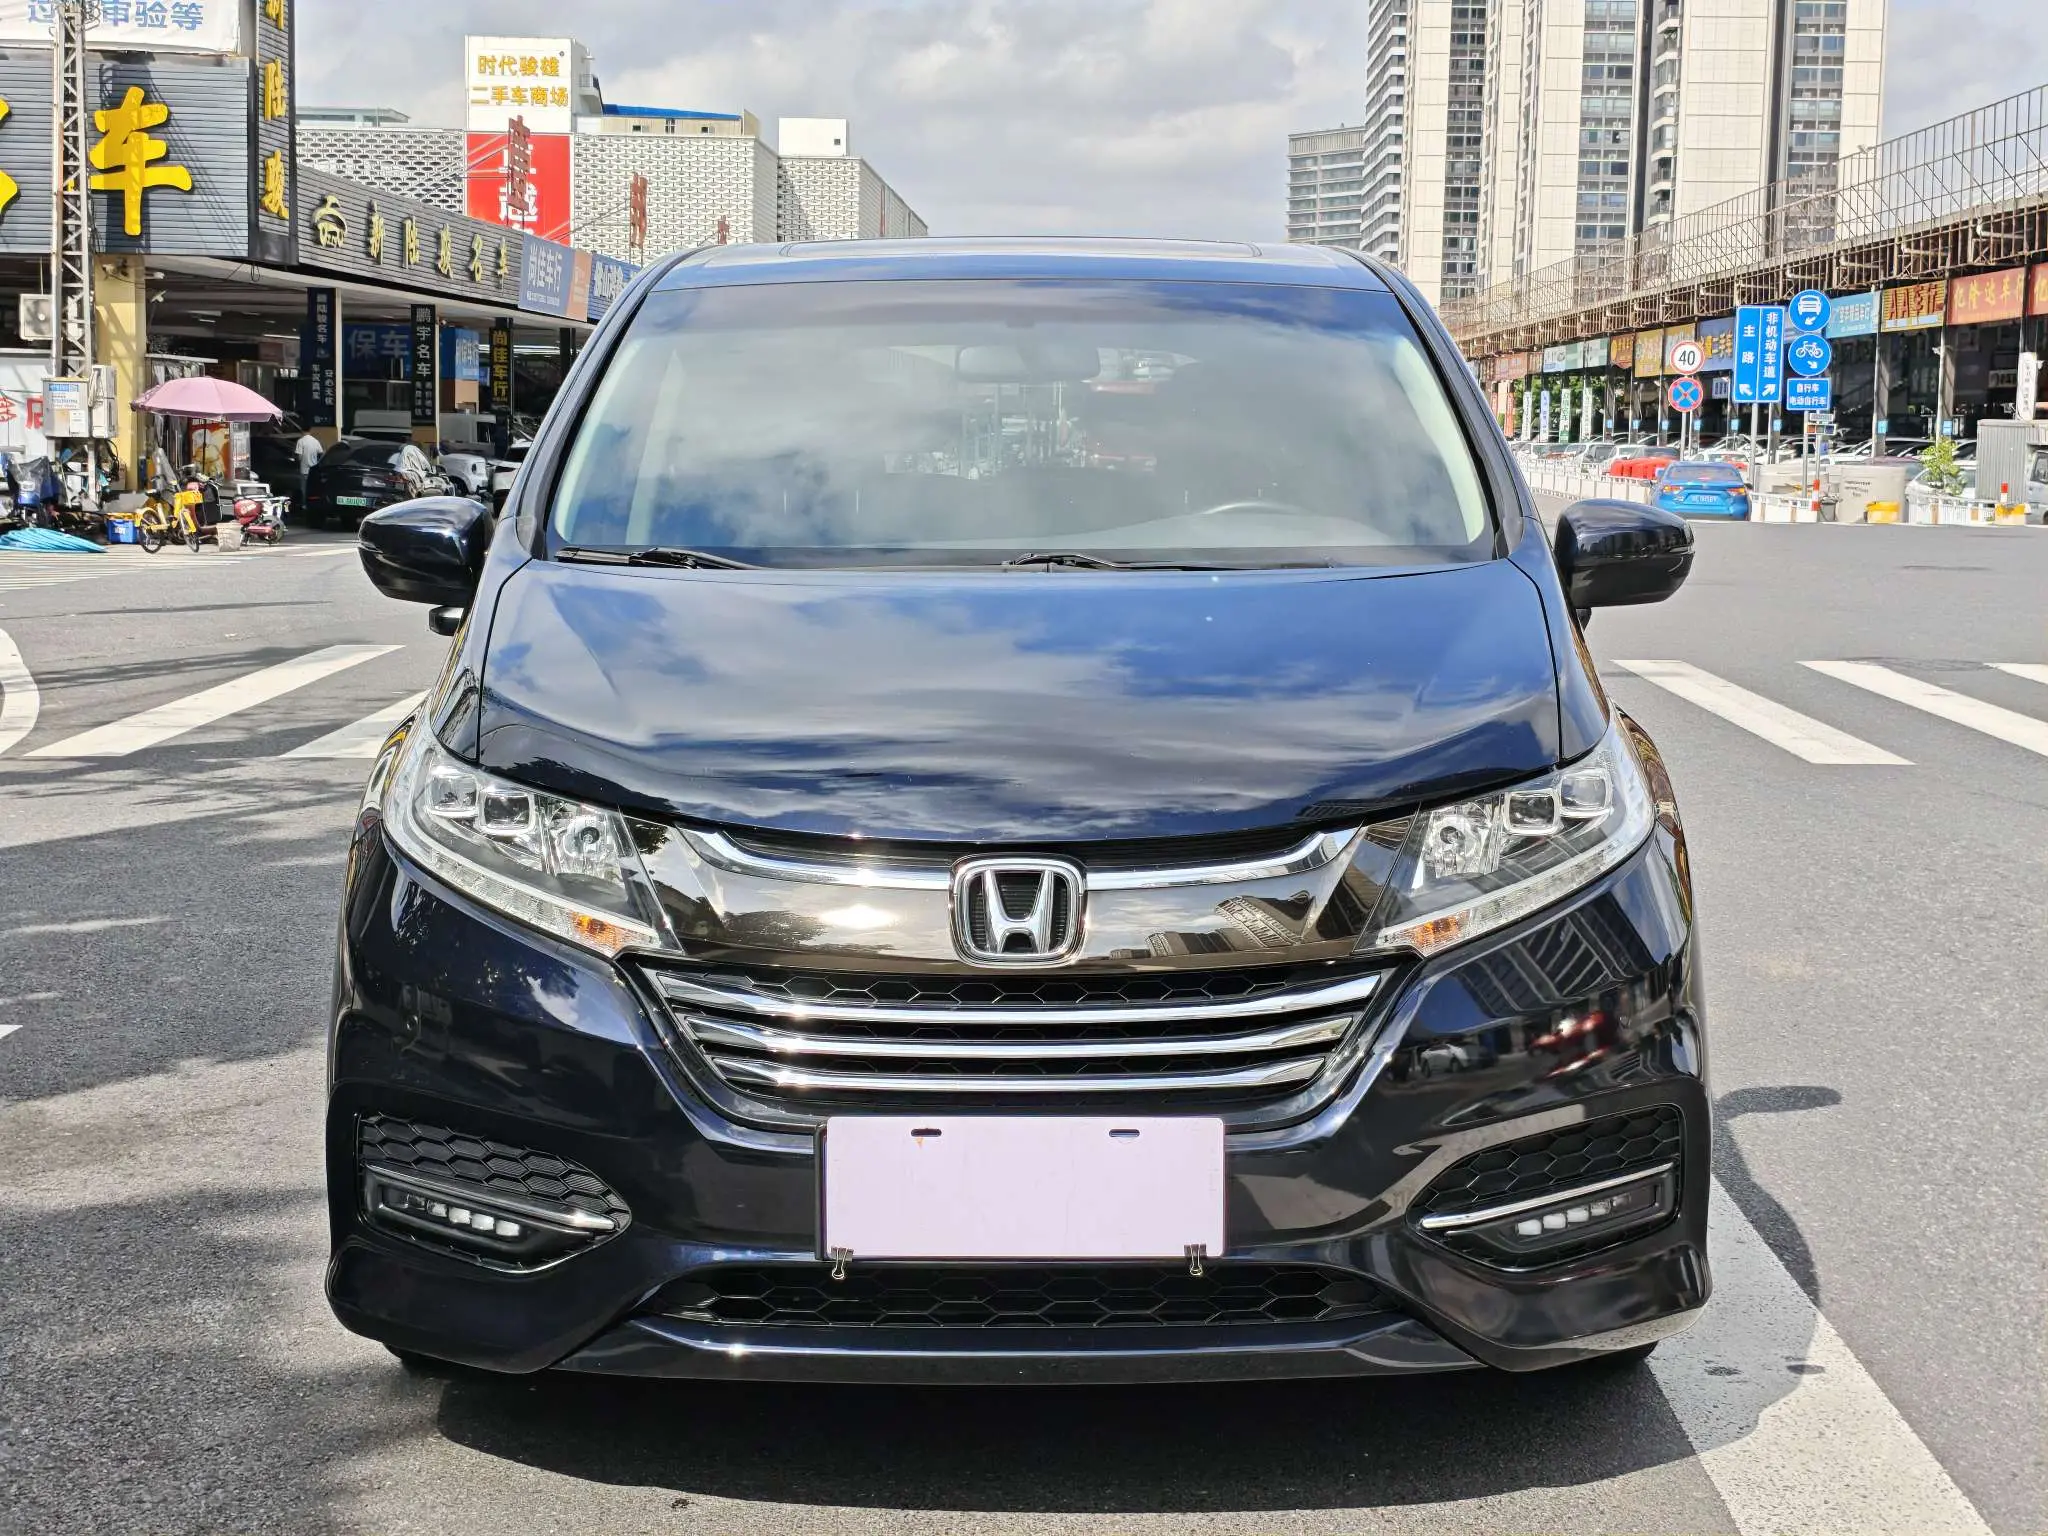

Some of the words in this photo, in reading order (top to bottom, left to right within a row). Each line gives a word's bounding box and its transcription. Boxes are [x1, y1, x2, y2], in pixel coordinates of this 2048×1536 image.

[28, 0, 204, 30] 过审验等
[478, 55, 560, 77] 时代骏雄
[470, 86, 569, 107] 二手车商场
[1742, 325, 1755, 364] 主路
[1763, 312, 1778, 378] 非机动车道
[1679, 350, 1696, 366] 40
[1796, 384, 1819, 393] 自行车
[1789, 396, 1826, 406] 电动自行车
